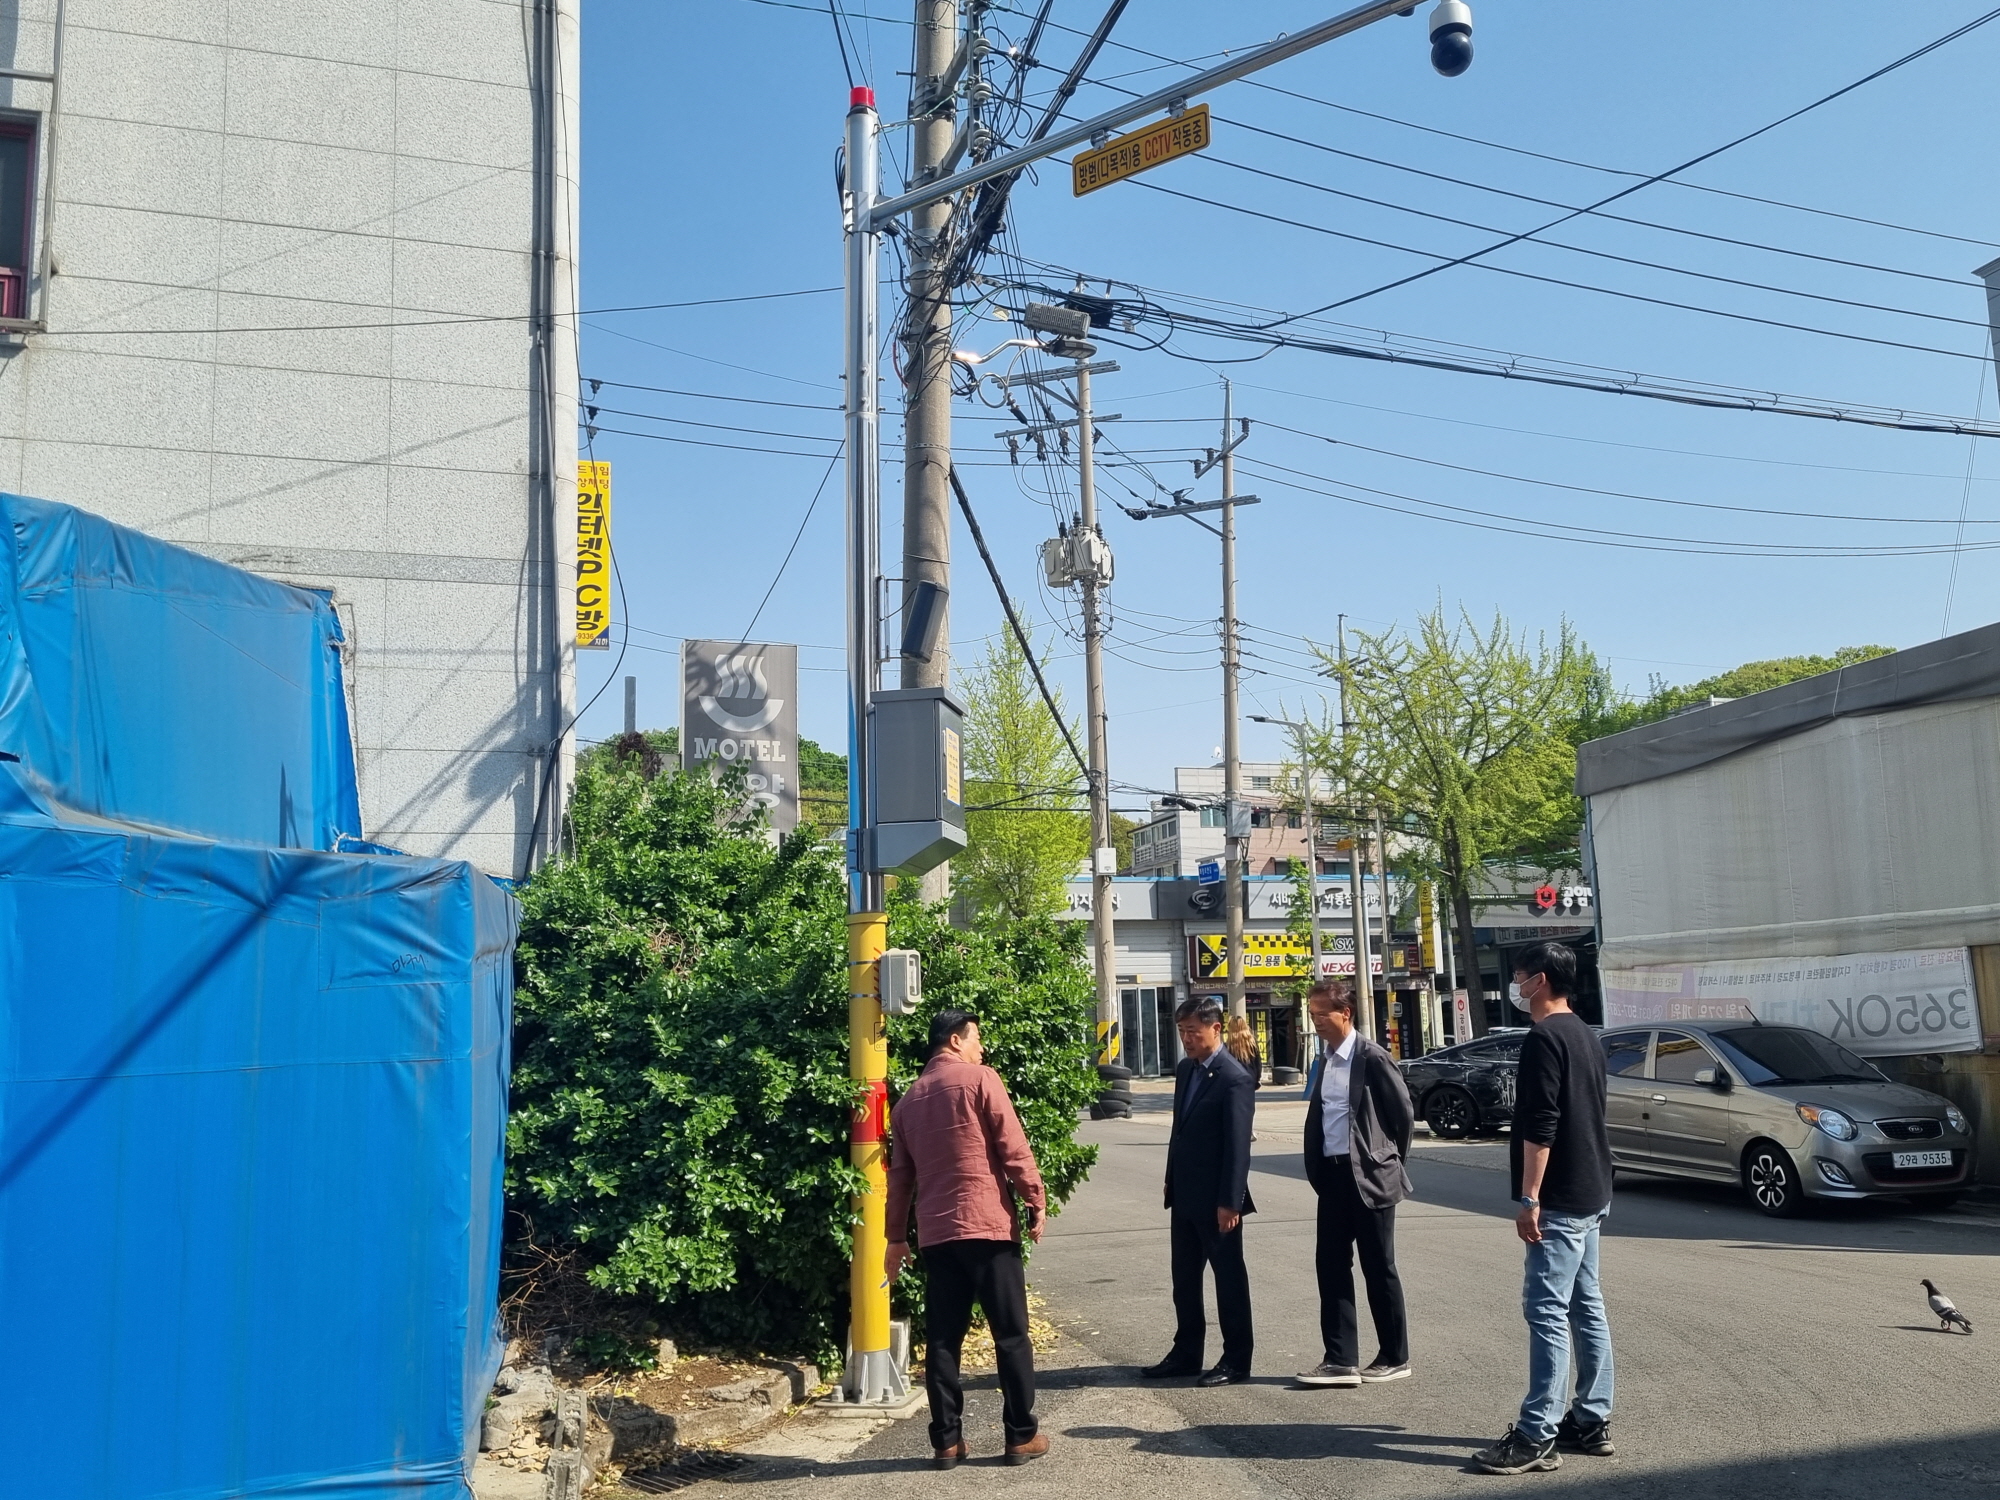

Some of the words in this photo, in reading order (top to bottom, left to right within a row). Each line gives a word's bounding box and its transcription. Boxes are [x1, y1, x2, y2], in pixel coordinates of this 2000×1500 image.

[1079, 143, 1141, 188] 방범(다목적)용
[694, 738, 786, 762] MOTEL
[1265, 955, 1281, 967] 용품
[1922, 1152, 1947, 1165] 9535
